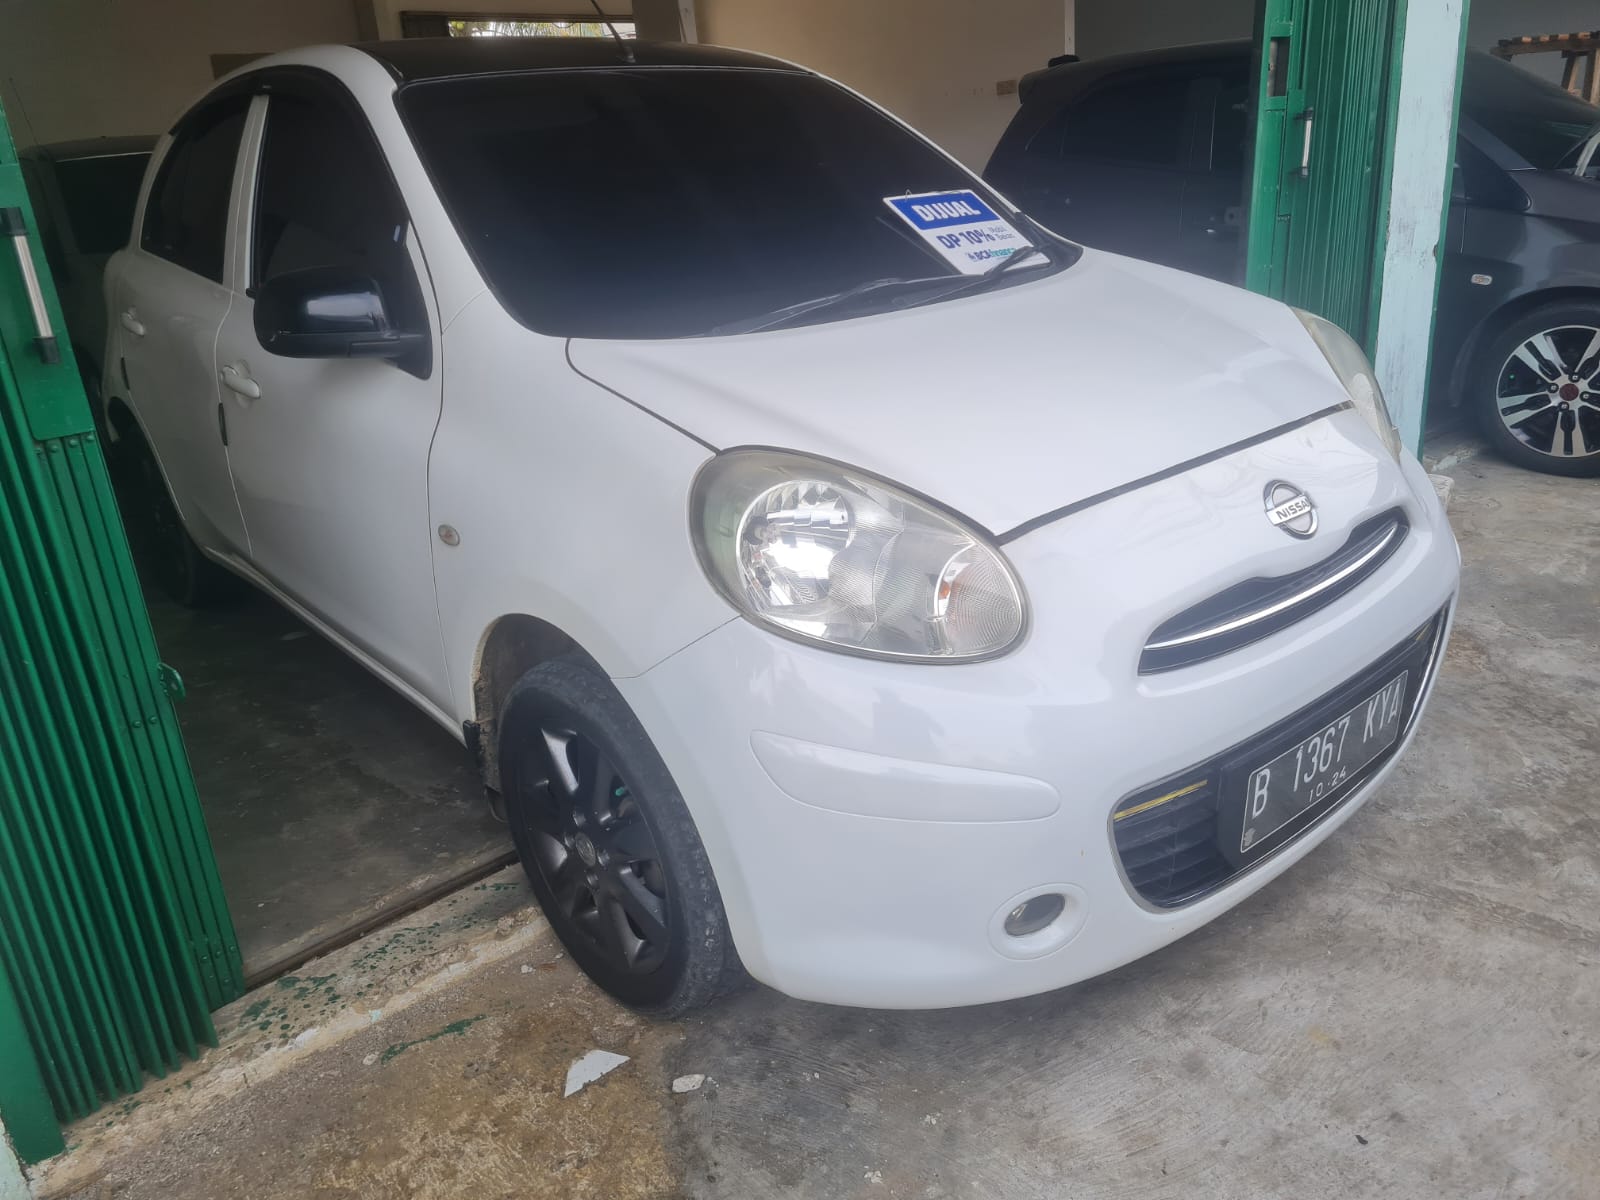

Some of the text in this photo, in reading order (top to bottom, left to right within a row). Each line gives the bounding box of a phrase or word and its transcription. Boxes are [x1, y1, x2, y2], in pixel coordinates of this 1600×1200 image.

[911, 200, 982, 222] DIJUAL
[936, 229, 996, 249] DP 10%
[1252, 678, 1401, 819] B 1367 KYA
